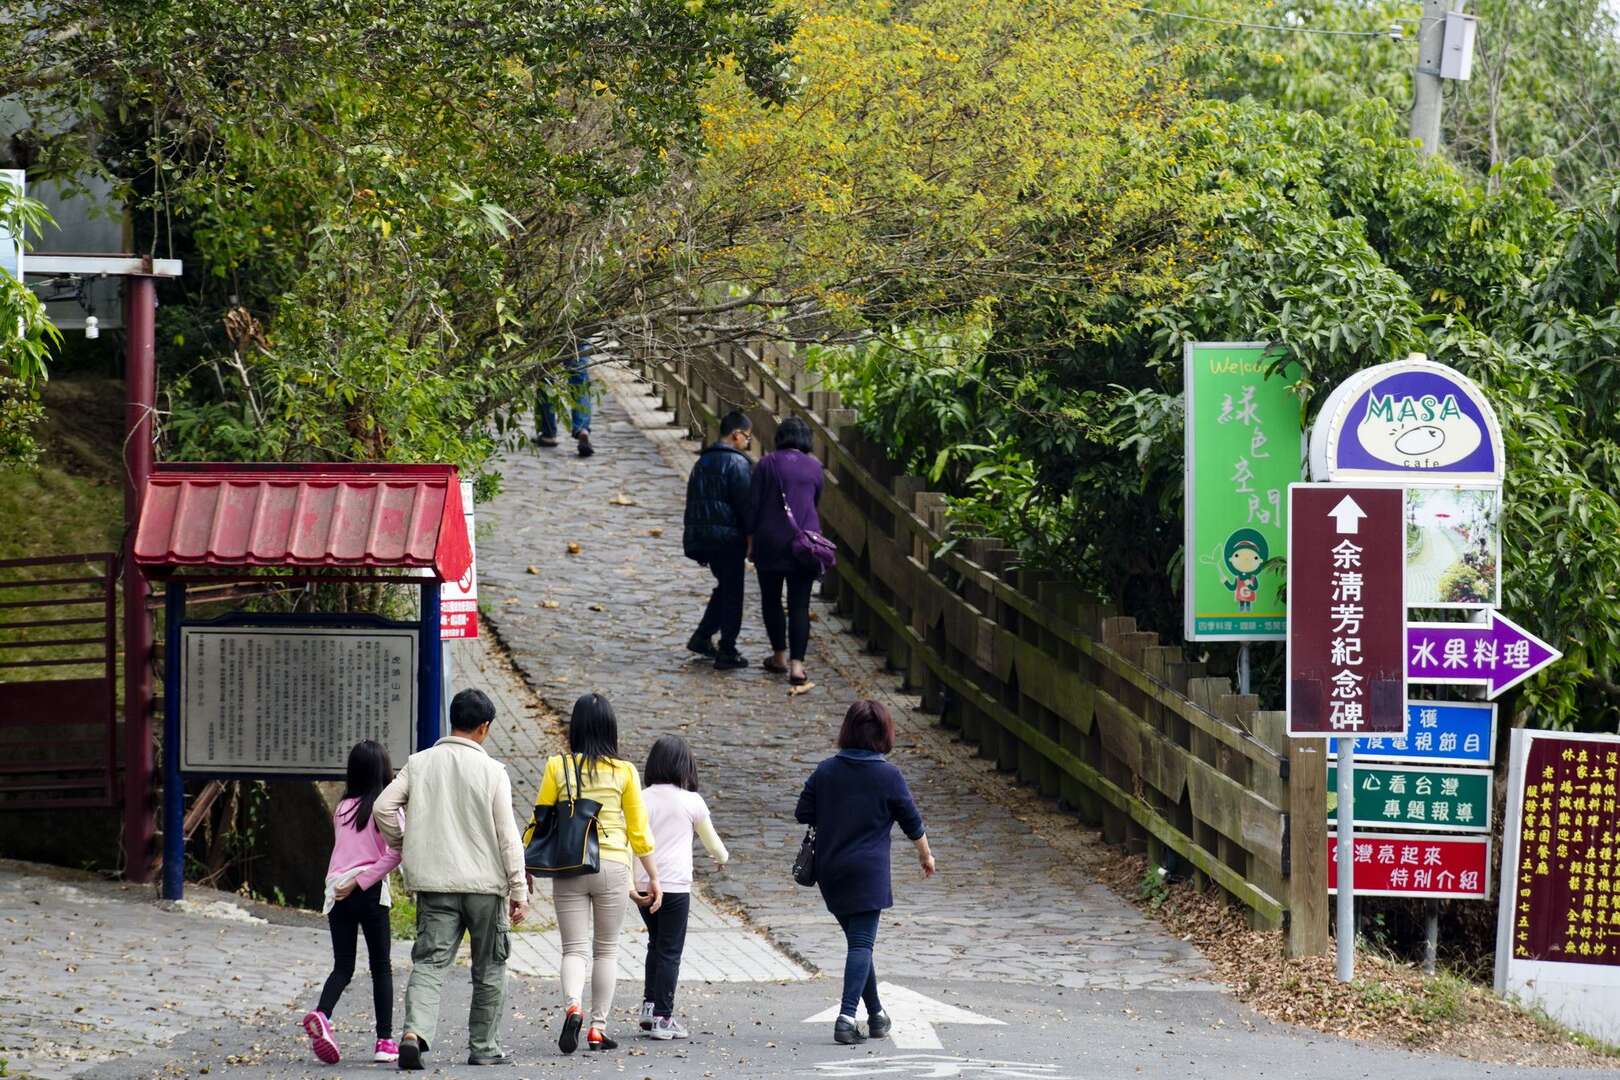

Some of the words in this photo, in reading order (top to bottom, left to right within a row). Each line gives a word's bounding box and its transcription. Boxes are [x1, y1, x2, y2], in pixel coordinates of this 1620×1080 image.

[1364, 394, 1461, 423] MASA
[1403, 458, 1440, 469] cafe
[1330, 540, 1364, 732] 余清芳紀念碑
[1411, 638, 1531, 670] 水果料理
[1408, 708, 1438, 728] 獲
[1362, 773, 1459, 797] 心看台灣
[1382, 799, 1474, 823] 專題報導
[1390, 868, 1479, 891] 特別介紹
